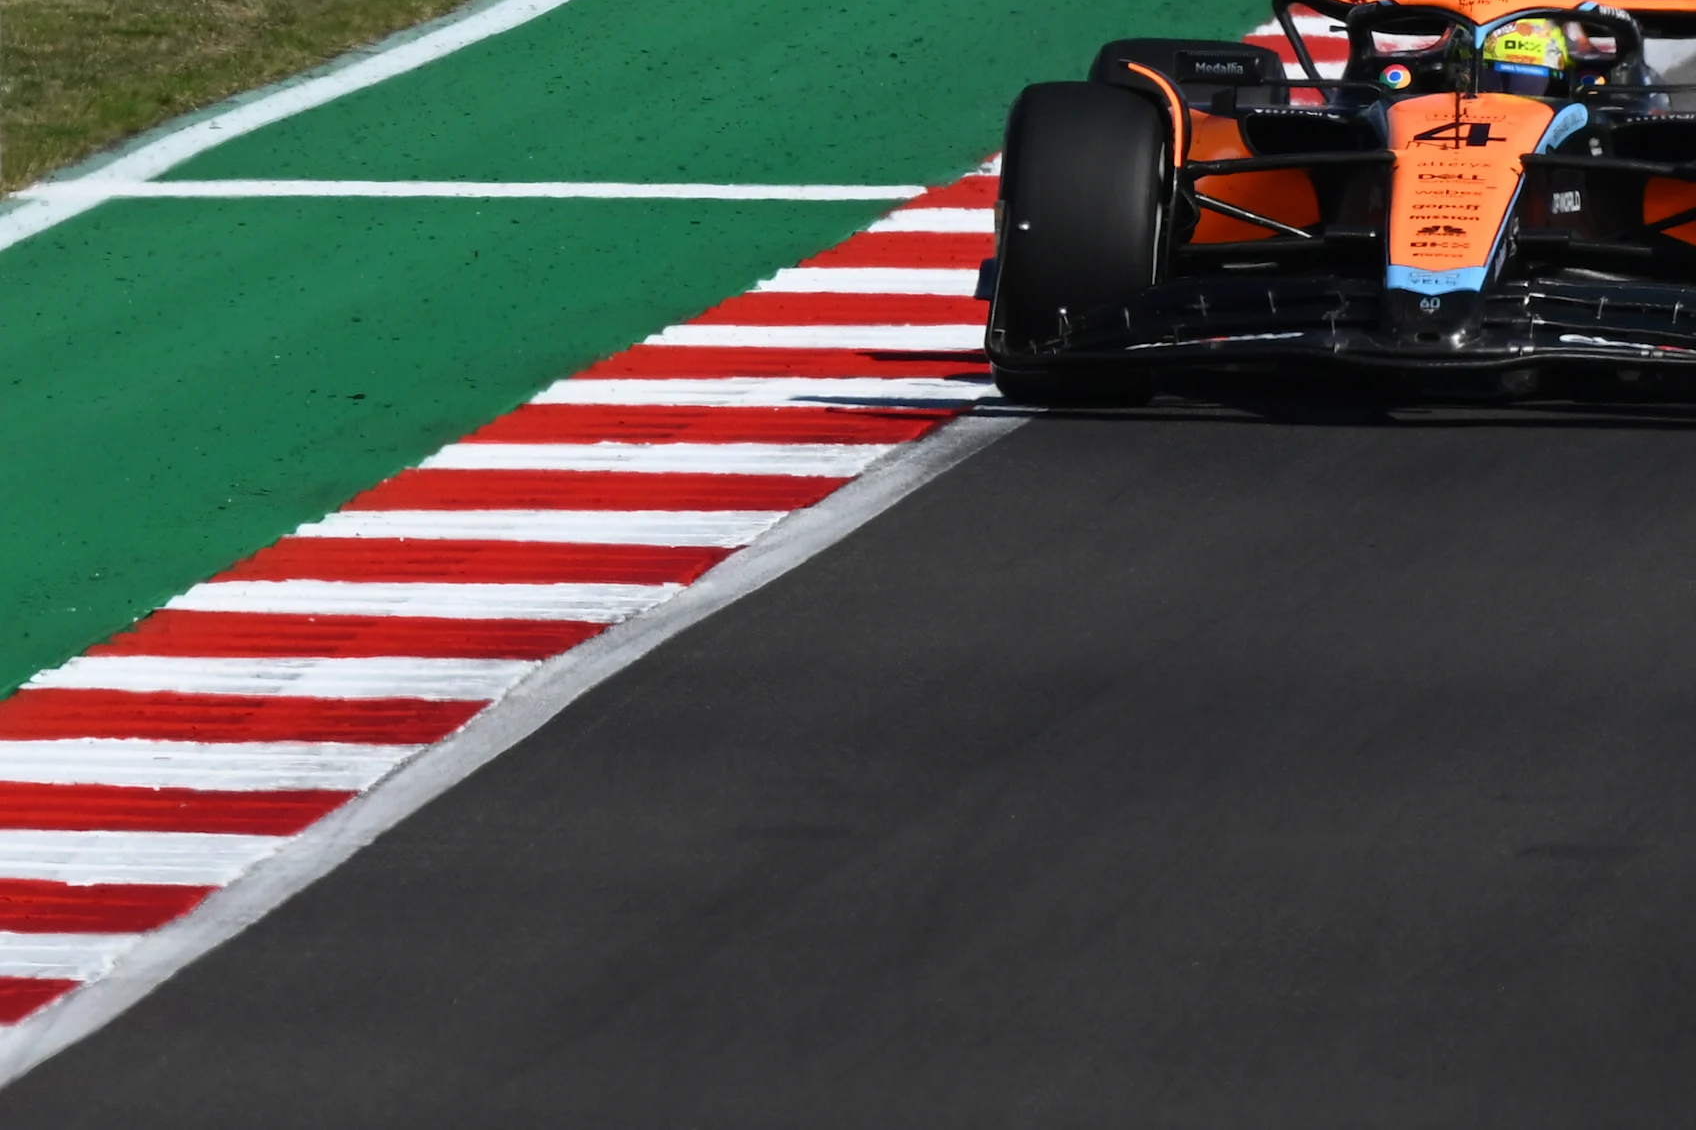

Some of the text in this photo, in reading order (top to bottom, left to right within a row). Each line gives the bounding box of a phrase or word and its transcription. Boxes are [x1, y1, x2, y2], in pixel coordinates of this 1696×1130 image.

[1195, 61, 1244, 75] Medallia
[1413, 122, 1508, 147] 4
[1419, 297, 1441, 309] 60
